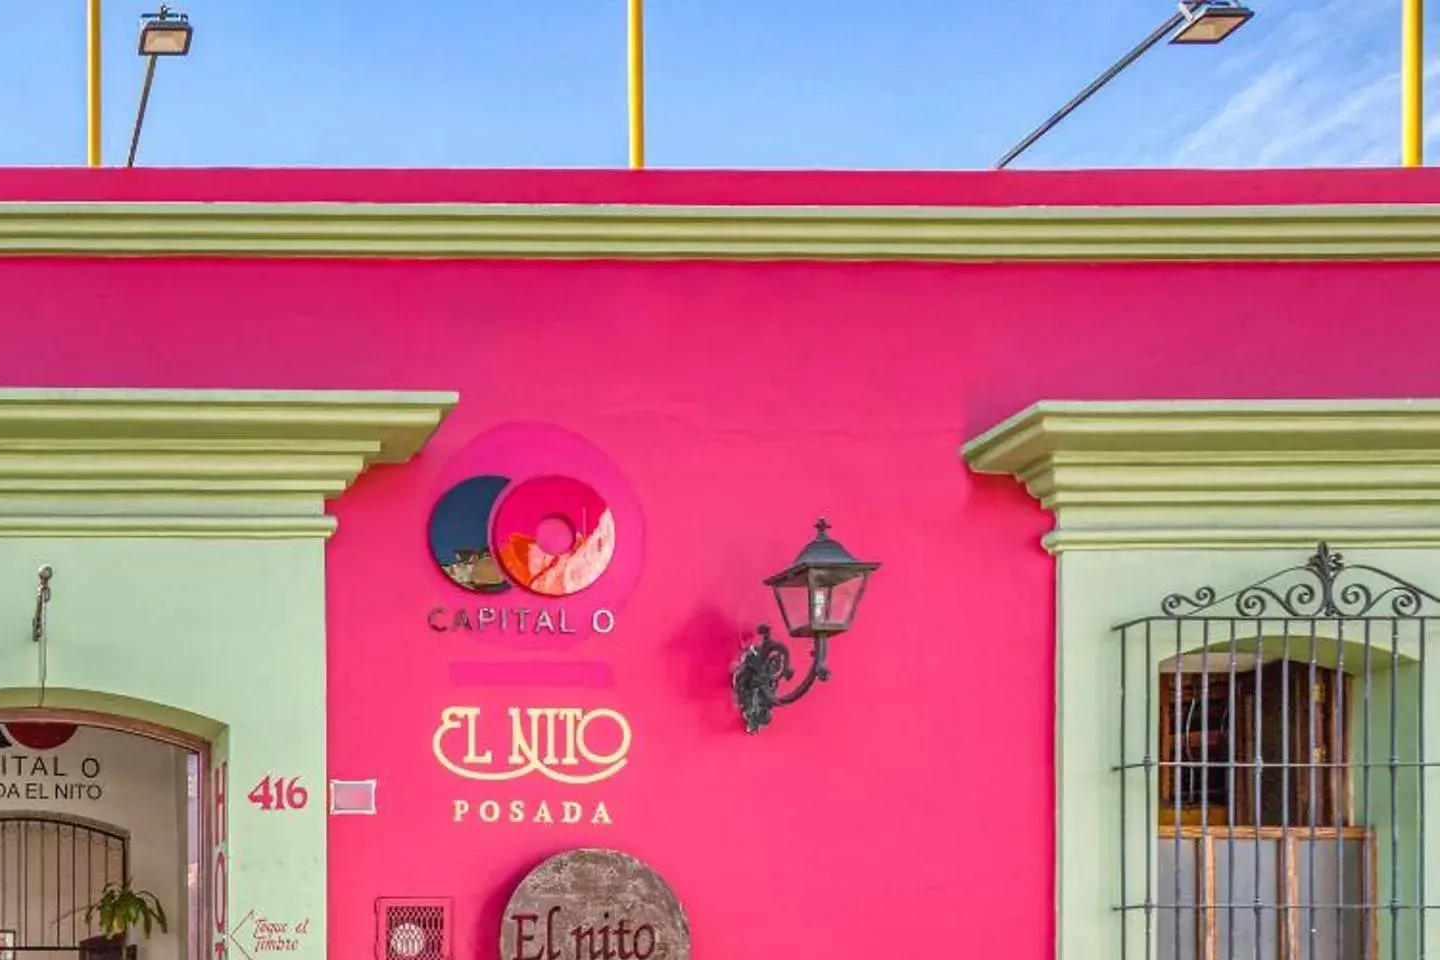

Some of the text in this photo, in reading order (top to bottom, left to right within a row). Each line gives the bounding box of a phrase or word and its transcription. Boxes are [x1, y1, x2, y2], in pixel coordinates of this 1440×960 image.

[428, 606, 616, 634] CAPITAL O
[432, 706, 632, 784] EL NITO
[81, 757, 101, 779] O
[24, 783, 49, 800] EL
[54, 783, 104, 801] NITO
[247, 774, 309, 811] 416
[453, 800, 612, 824] POSADA
